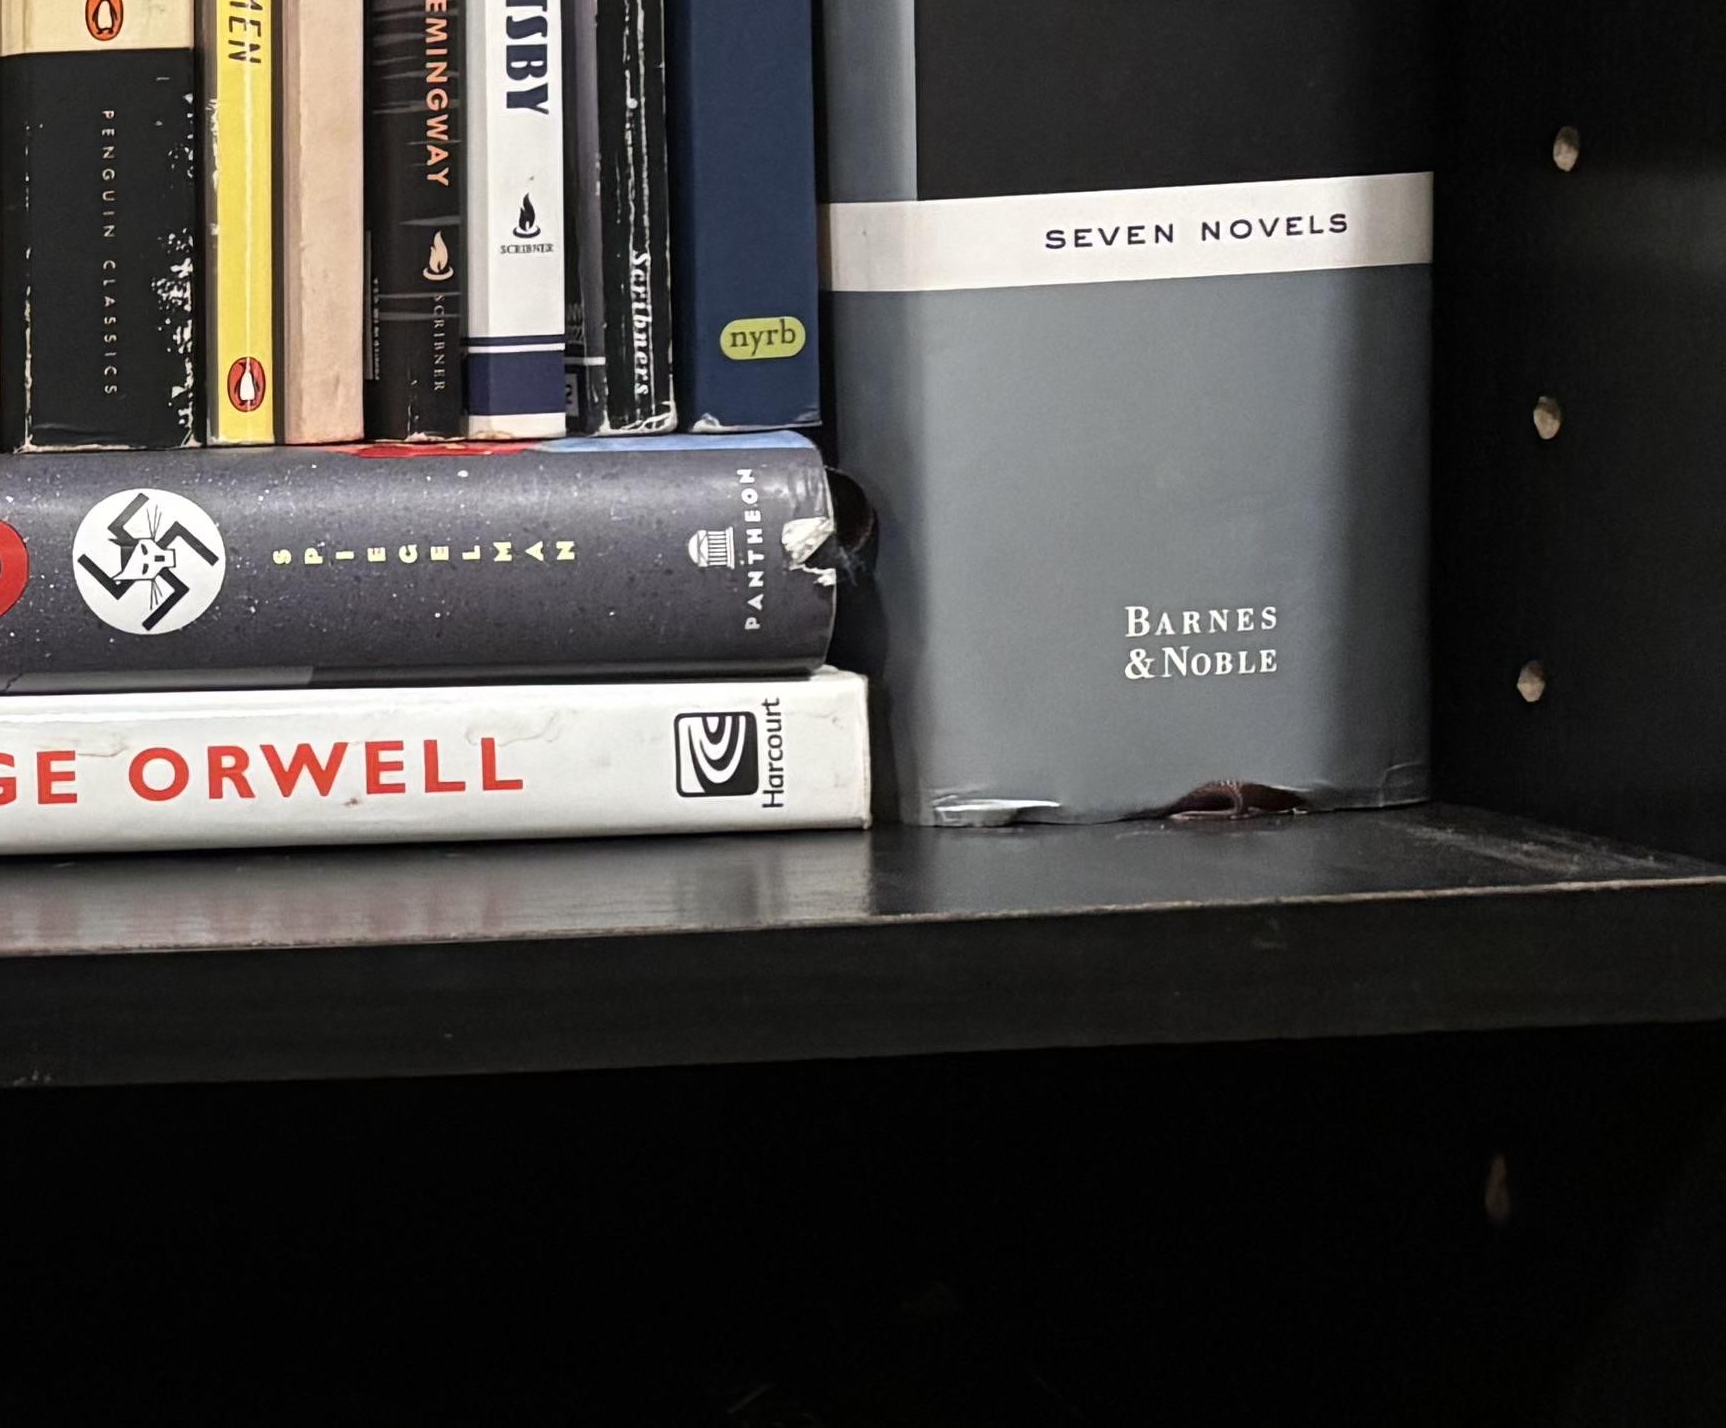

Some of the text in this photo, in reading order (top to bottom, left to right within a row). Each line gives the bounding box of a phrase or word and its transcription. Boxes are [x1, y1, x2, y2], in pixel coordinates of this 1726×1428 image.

[1044, 212, 1348, 250] SEVEN NOVELS
[728, 319, 796, 355] nyrb
[1125, 605, 1277, 638] BARNES
[128, 737, 524, 802] ORWELL
[761, 697, 785, 809] Harcourt
